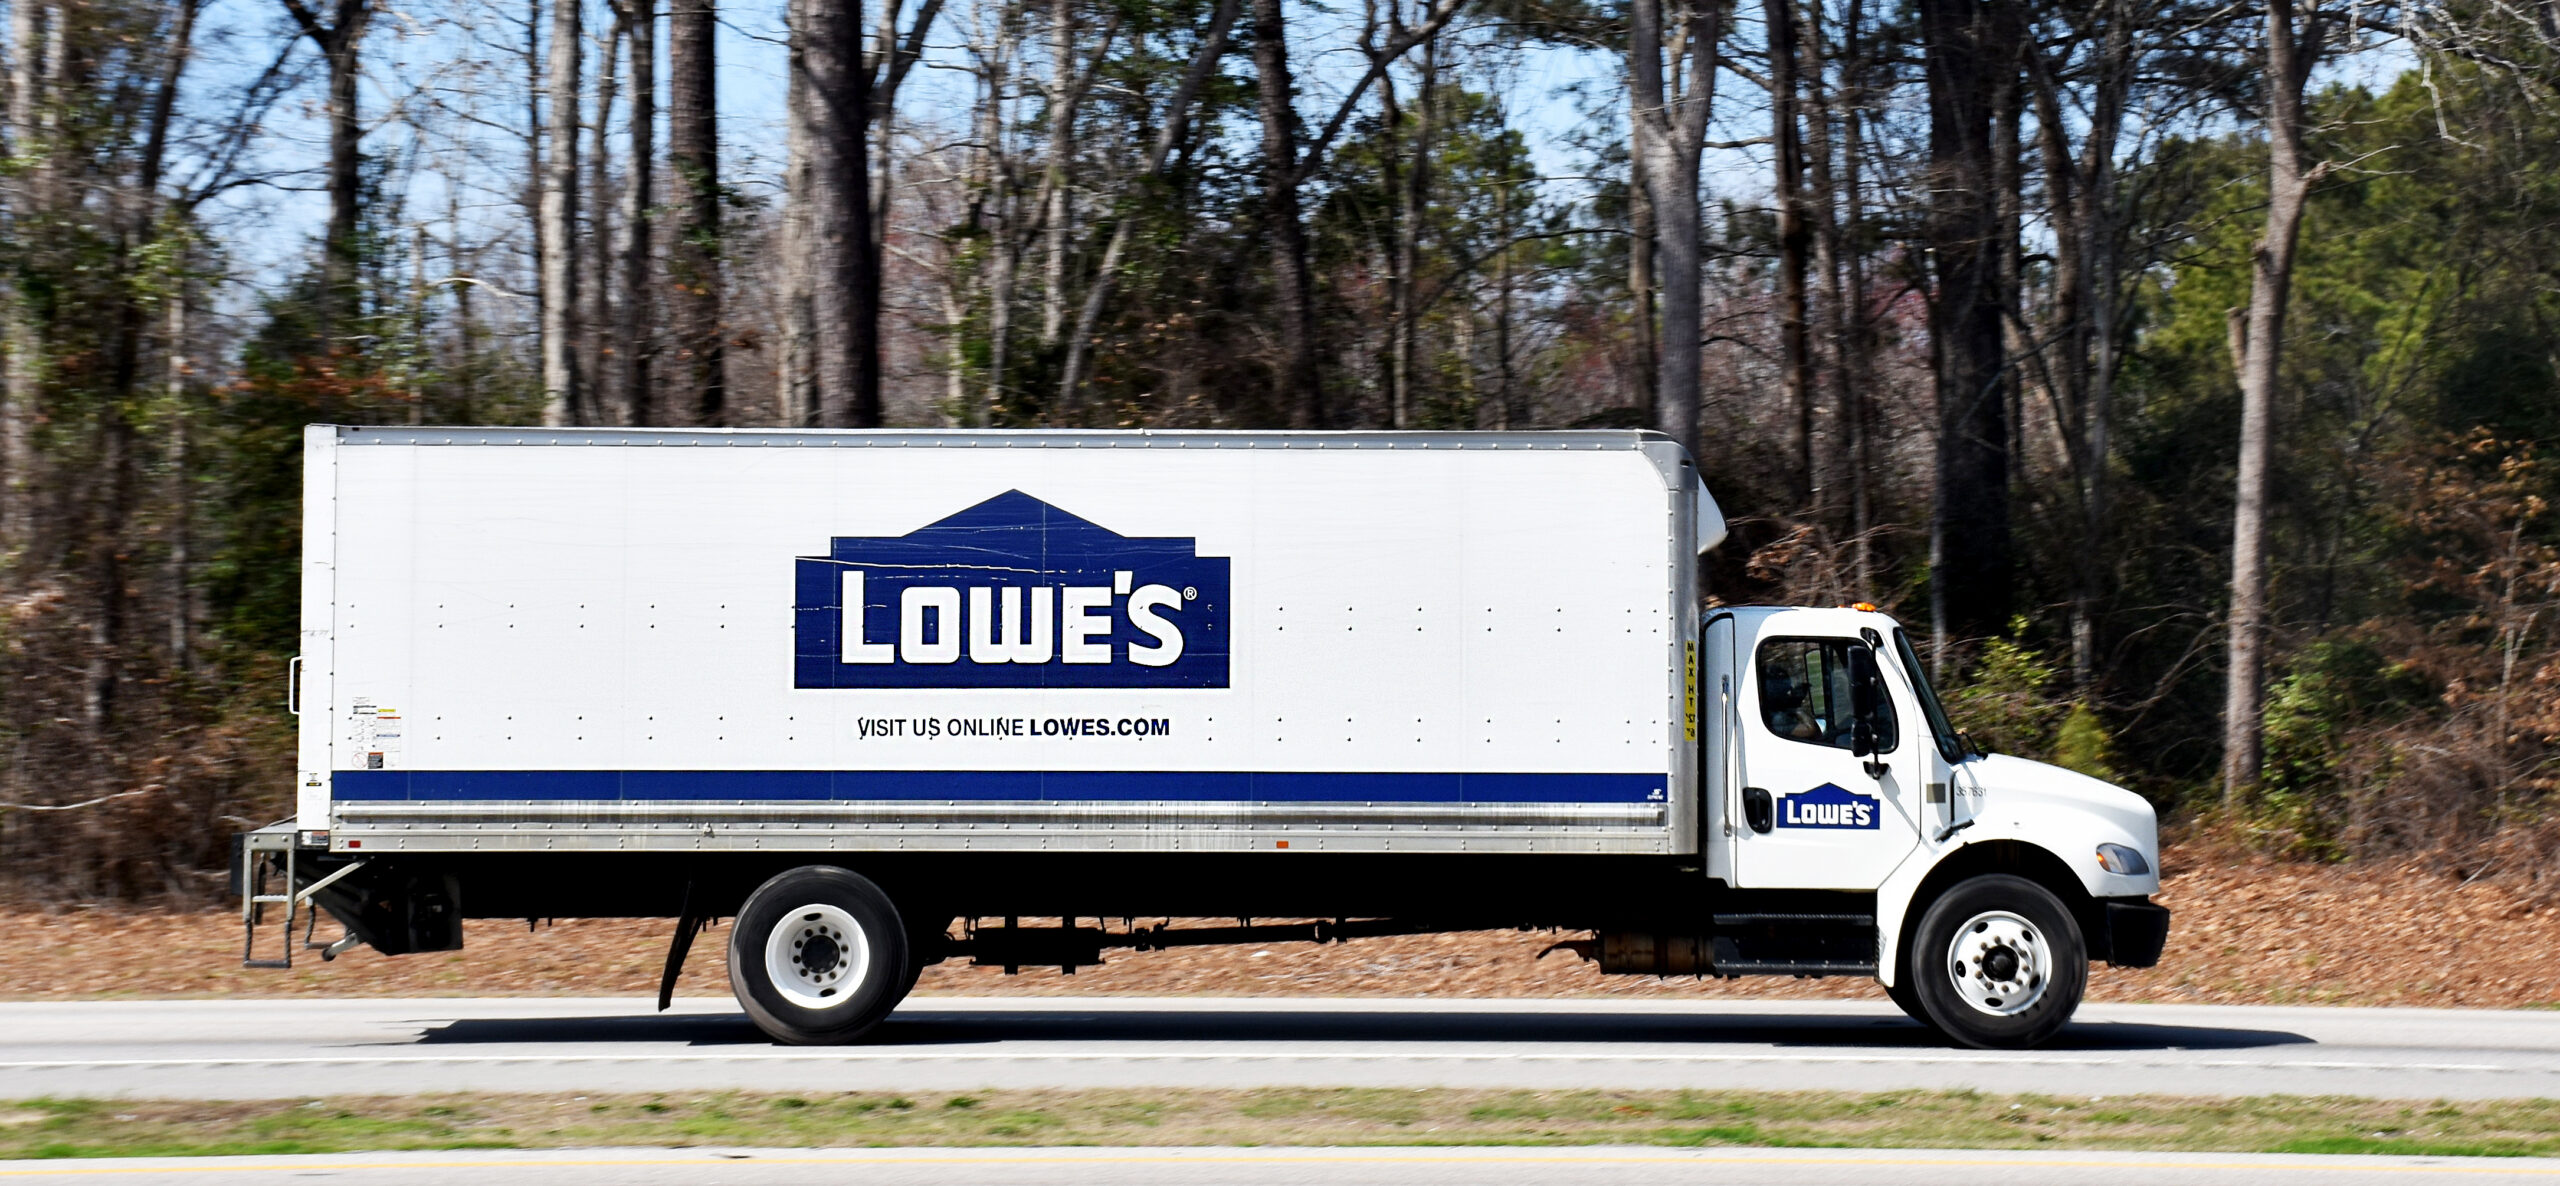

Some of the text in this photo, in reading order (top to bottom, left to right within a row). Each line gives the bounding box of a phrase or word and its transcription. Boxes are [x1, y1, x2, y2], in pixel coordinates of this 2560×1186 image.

[858, 718, 1170, 737] VISIT US ONLINE LOWES.COM
